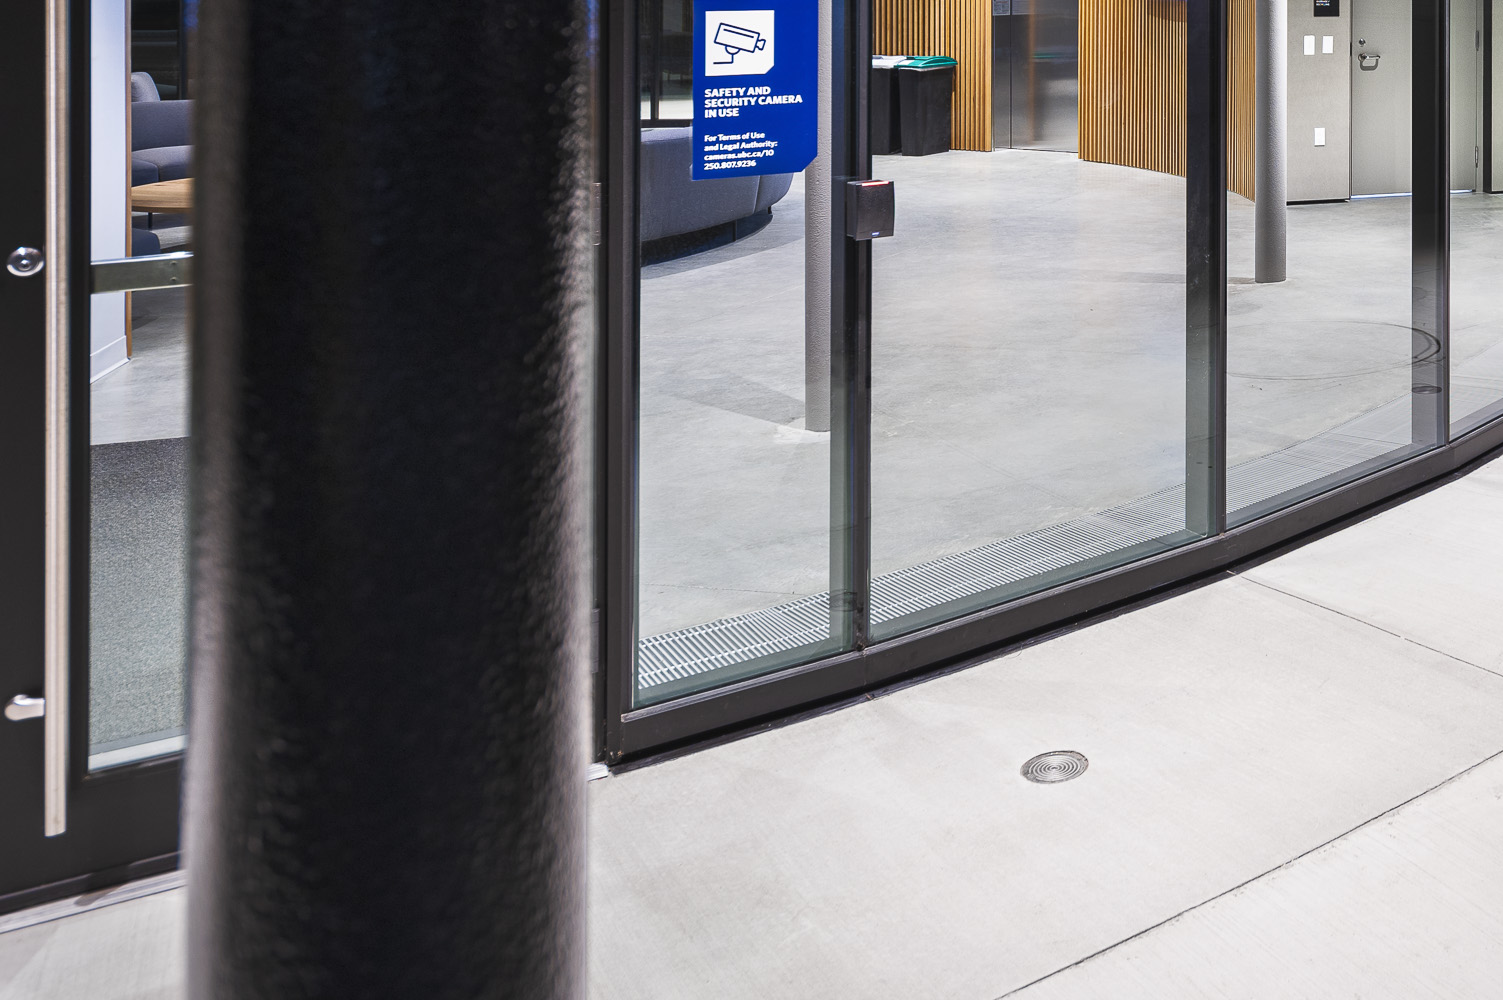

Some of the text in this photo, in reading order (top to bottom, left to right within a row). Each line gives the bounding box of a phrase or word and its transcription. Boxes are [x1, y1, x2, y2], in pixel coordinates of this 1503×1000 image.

[704, 86, 771, 98] SAFETY AND
[704, 94, 803, 108] SECURITY CAMERA
[704, 108, 739, 118] IN USE
[704, 134, 717, 142] For
[717, 133, 741, 141] Terms
[741, 132, 750, 140] of
[704, 140, 778, 152] and Legal Authority:
[704, 160, 757, 170] 250.807.9236
